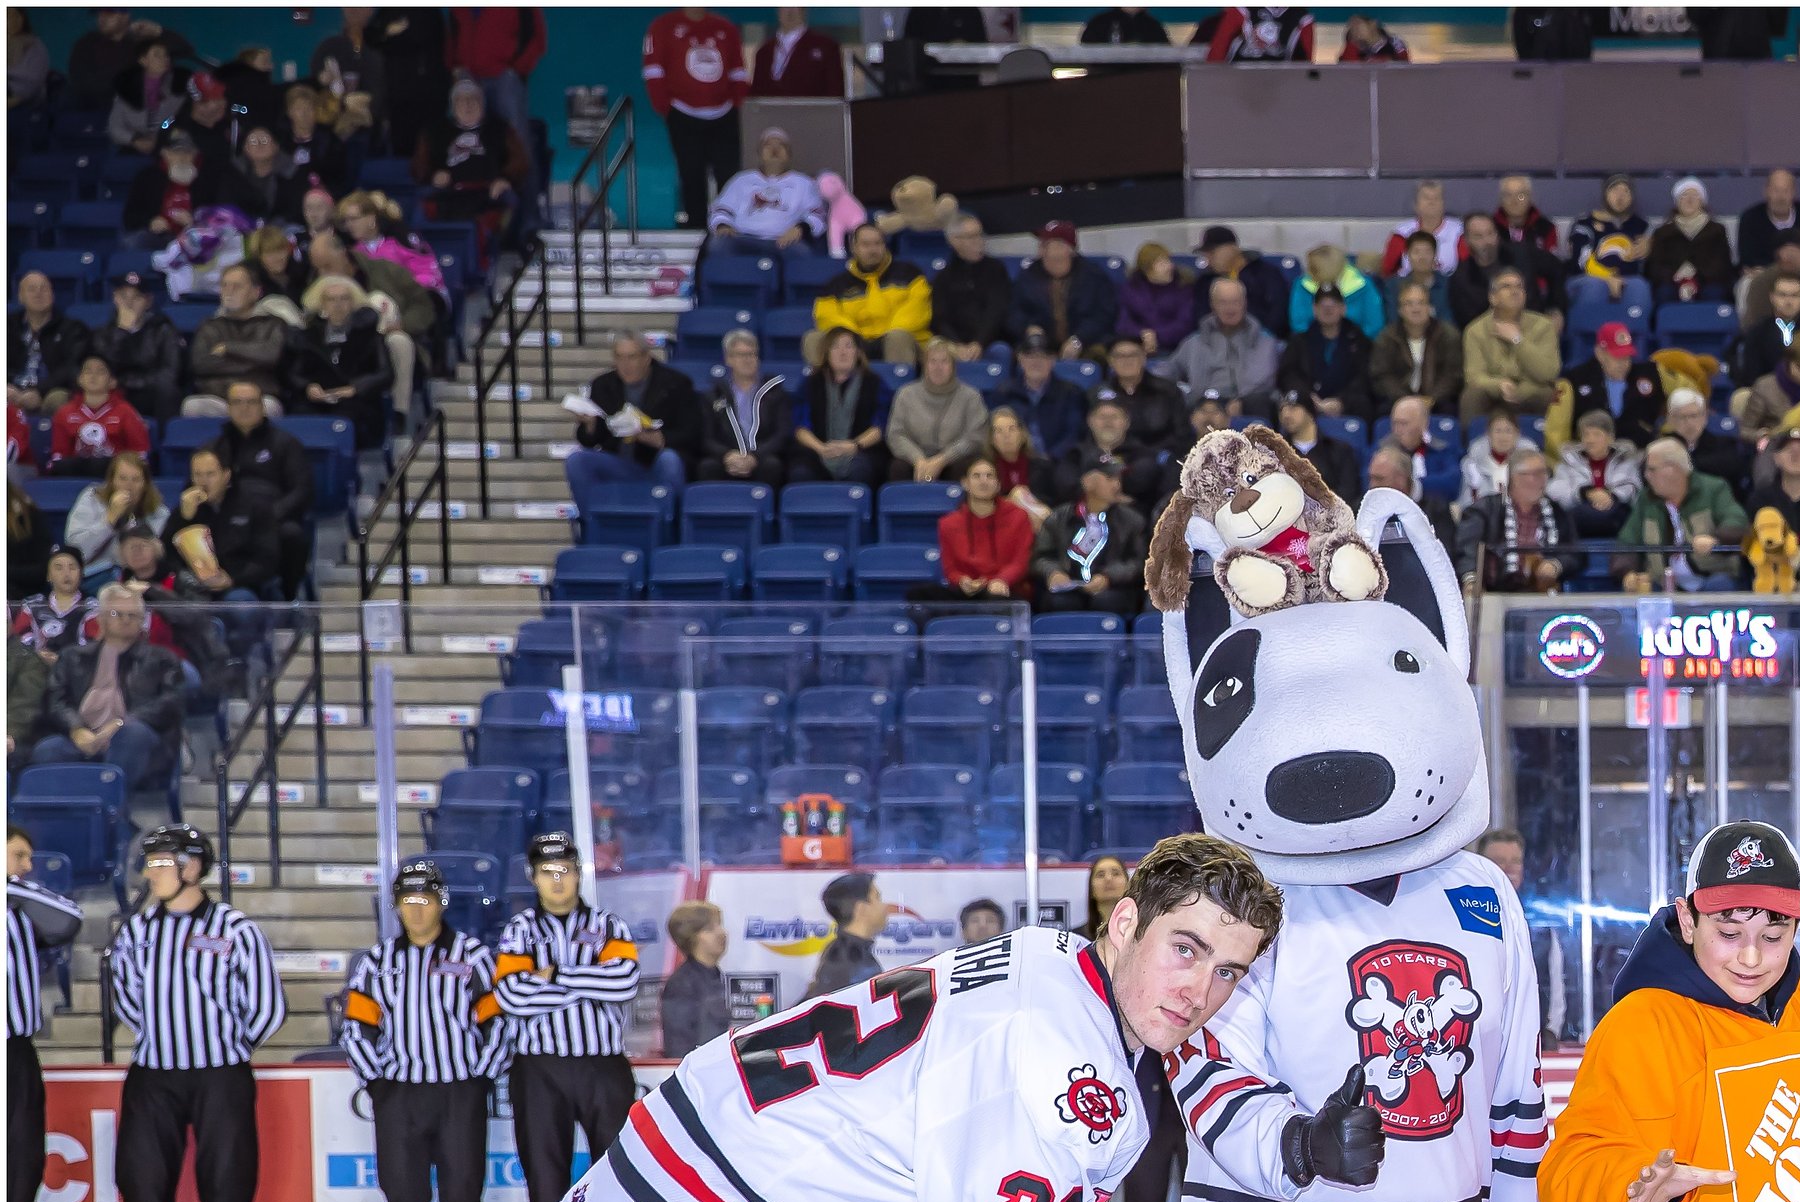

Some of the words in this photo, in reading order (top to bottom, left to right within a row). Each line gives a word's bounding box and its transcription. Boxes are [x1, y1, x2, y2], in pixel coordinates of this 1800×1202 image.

[950, 934, 1012, 995] THA
[1372, 956, 1392, 970] 10
[1394, 953, 1448, 969] YEARS
